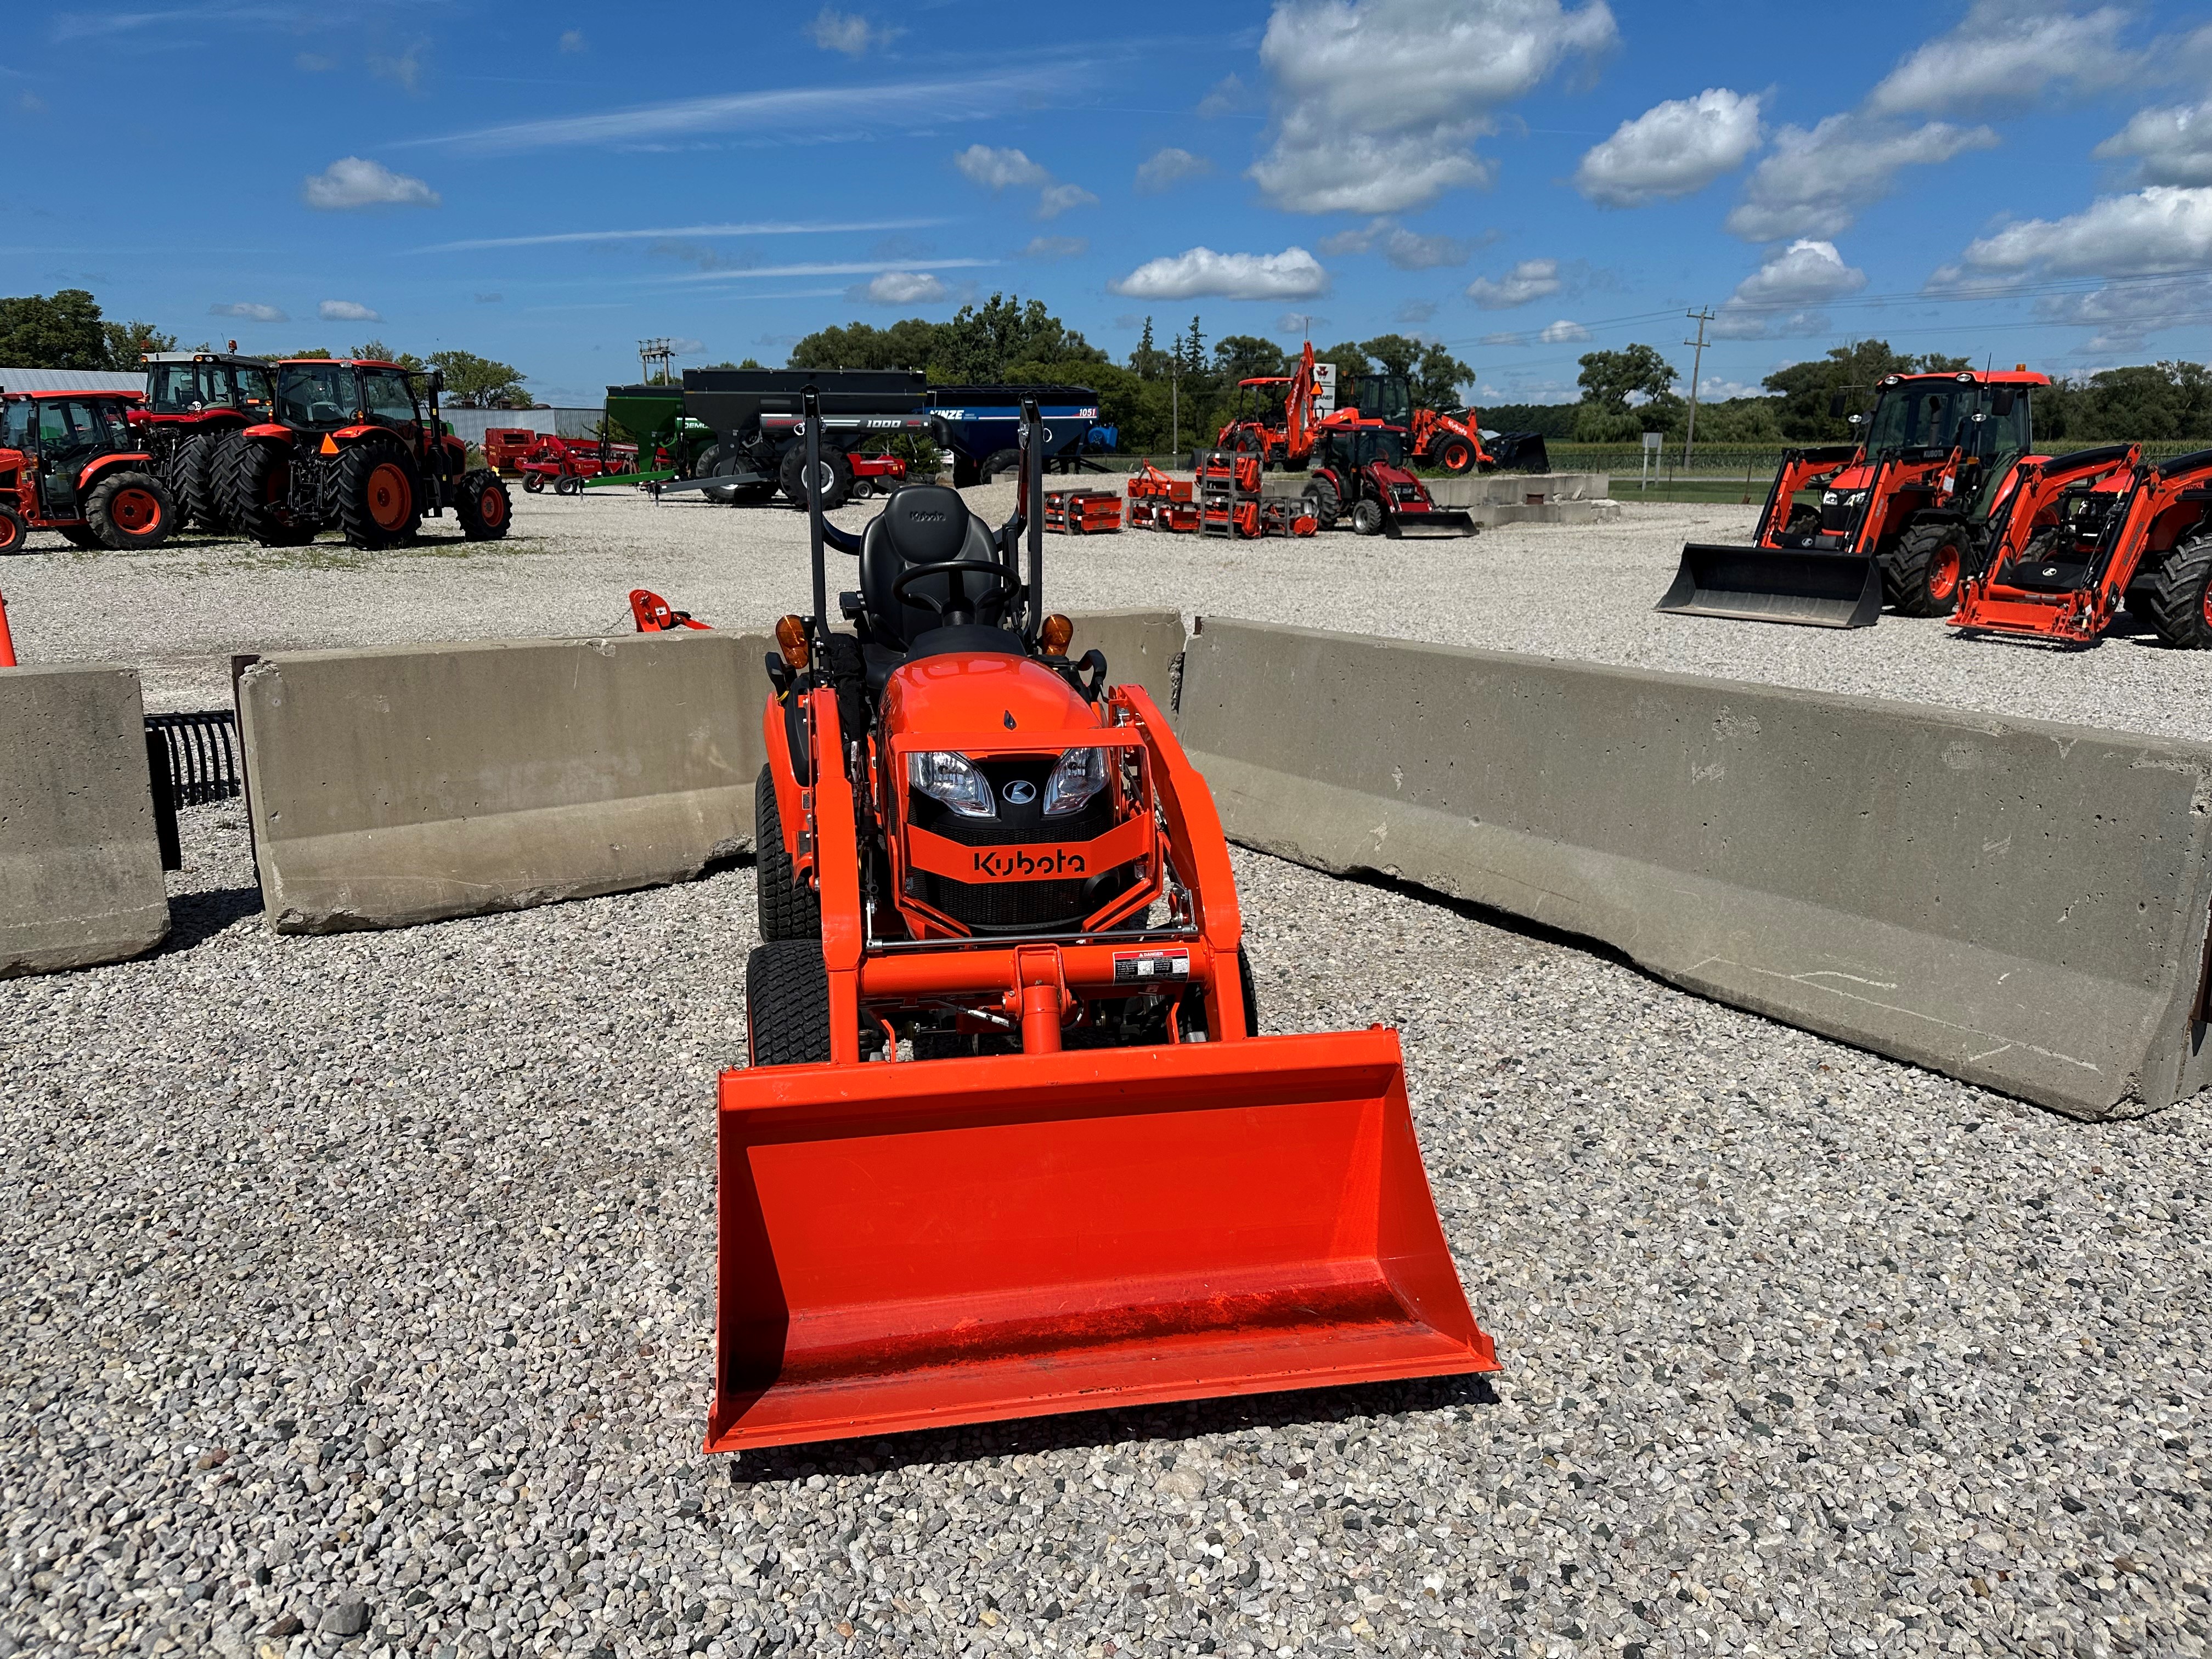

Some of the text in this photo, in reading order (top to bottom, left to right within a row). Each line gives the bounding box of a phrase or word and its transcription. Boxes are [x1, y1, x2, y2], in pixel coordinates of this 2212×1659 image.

[1079, 408, 1096, 417] 1051
[866, 420, 901, 428] 1000
[1923, 449, 1944, 458] KUBOTA
[910, 511, 946, 522] Kubota
[2123, 522, 2145, 566] KUBOTA
[974, 849, 1085, 877] Kubota
